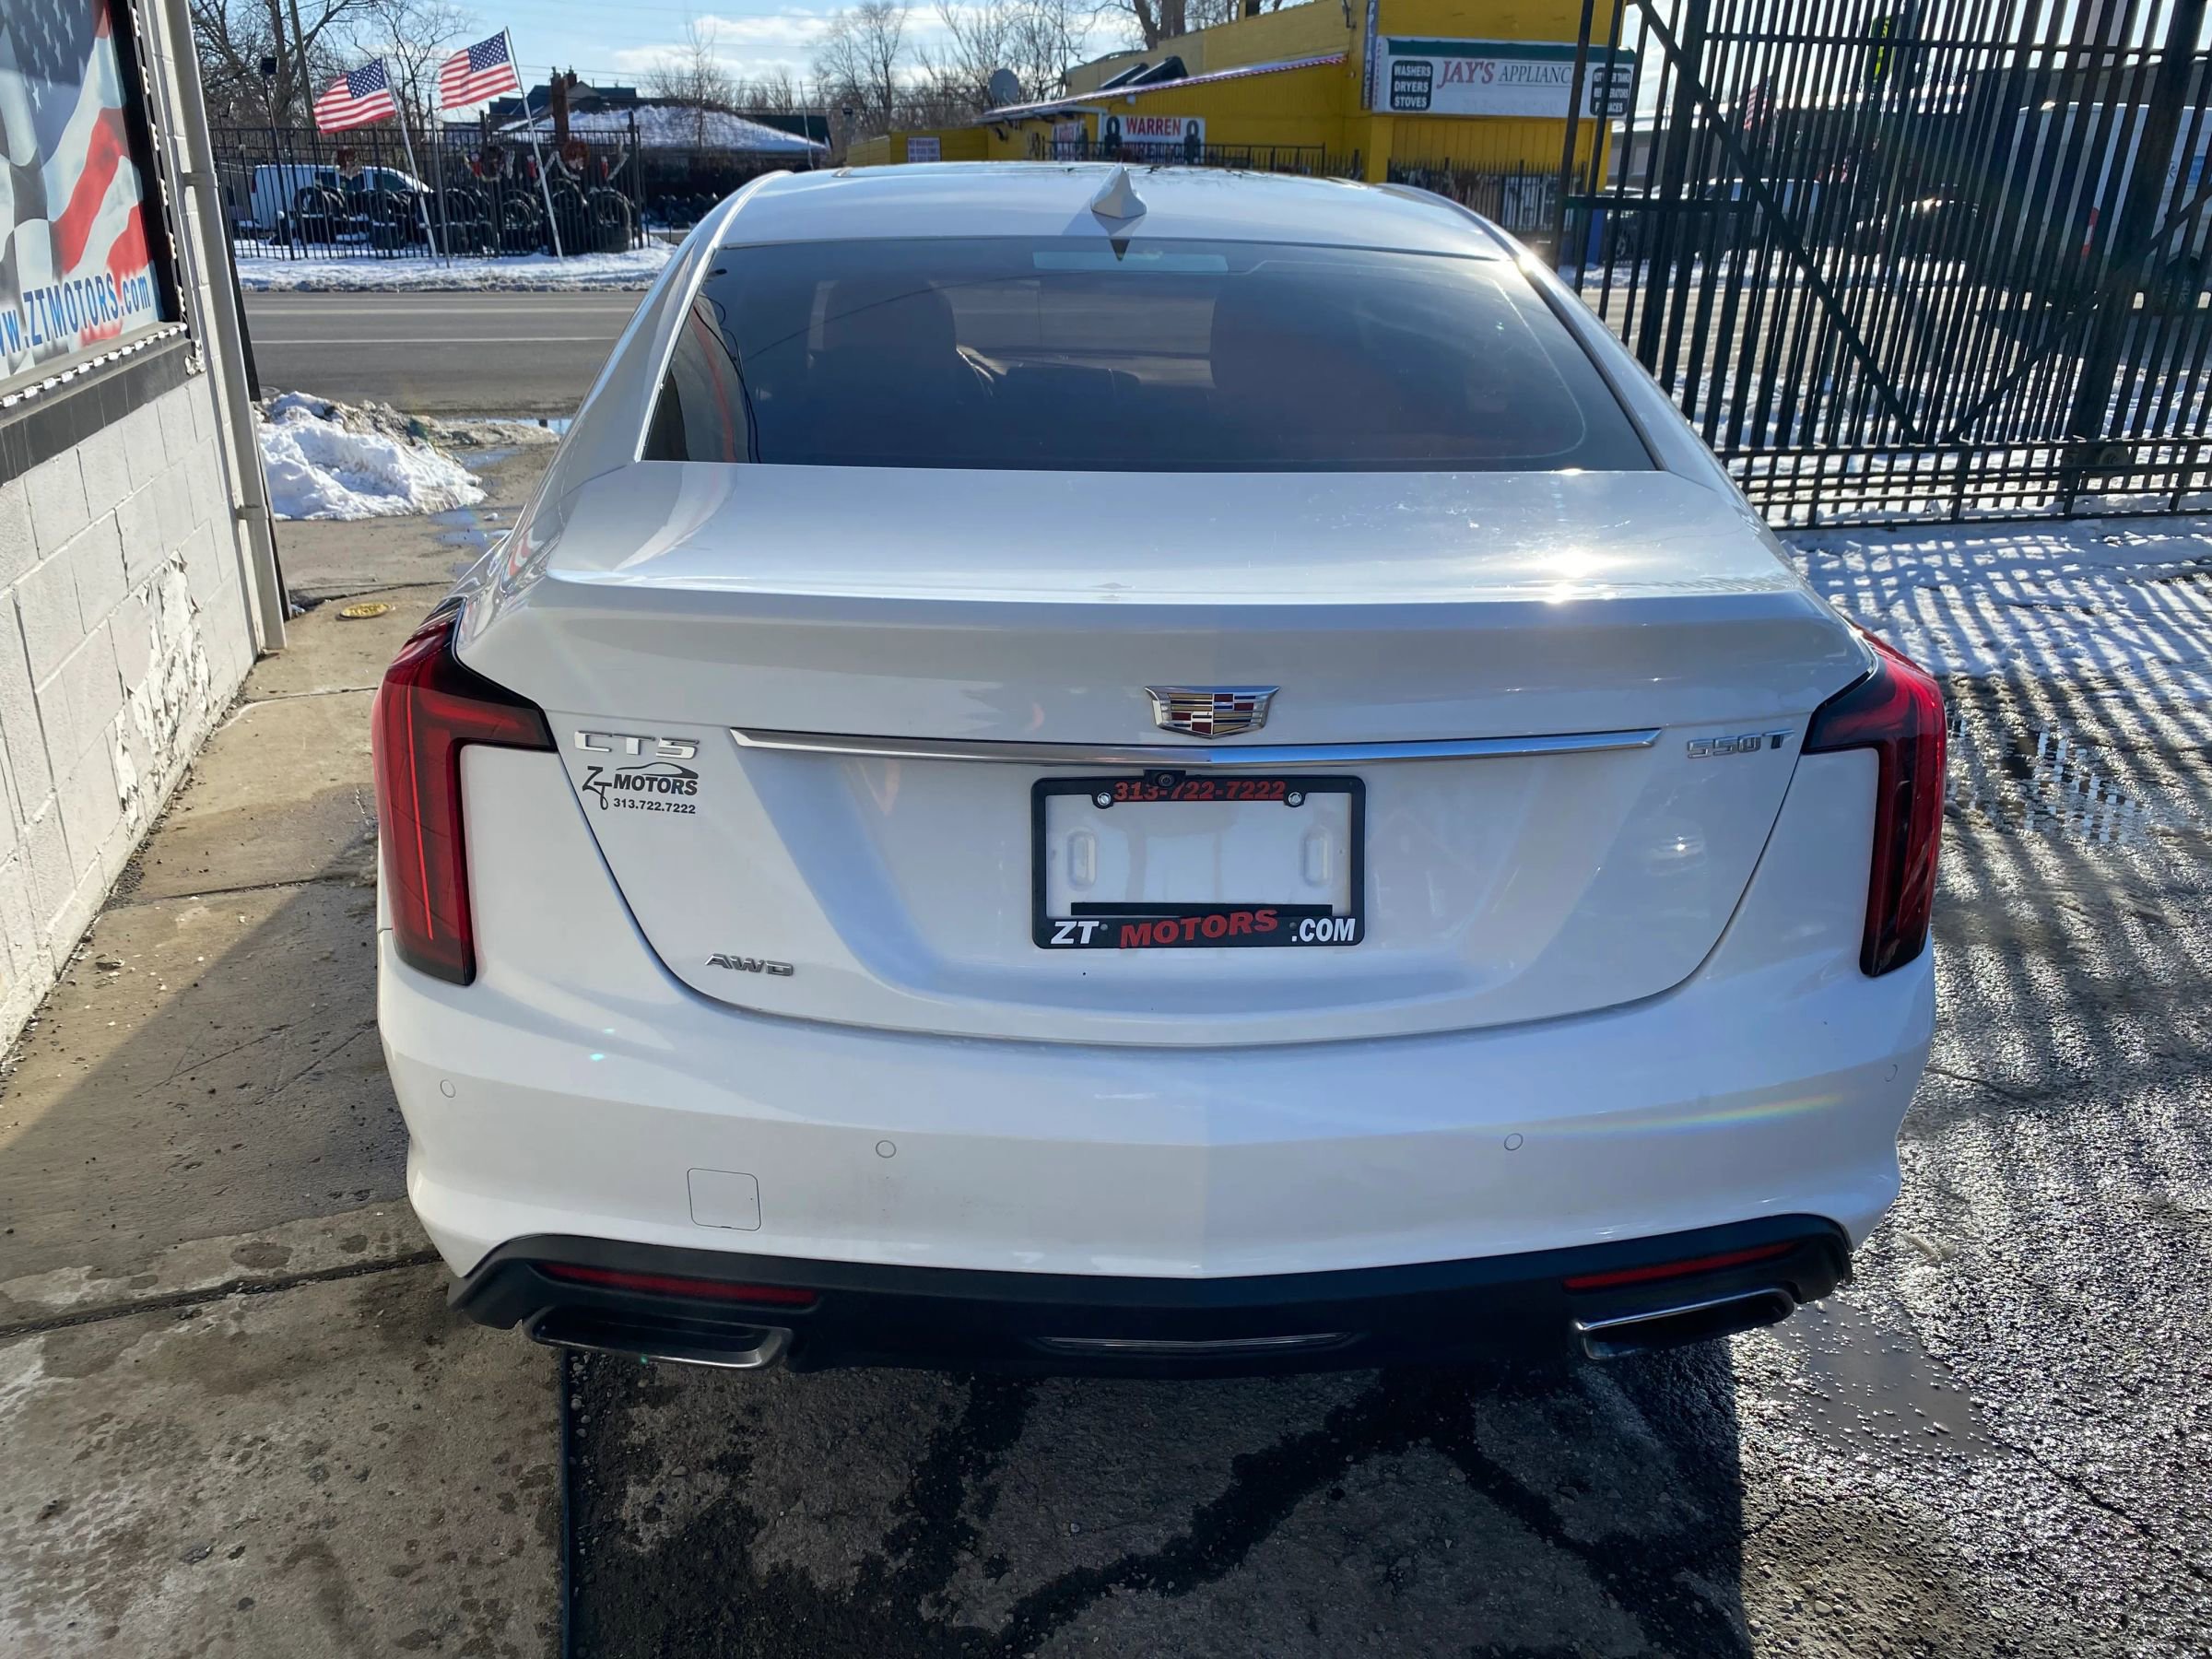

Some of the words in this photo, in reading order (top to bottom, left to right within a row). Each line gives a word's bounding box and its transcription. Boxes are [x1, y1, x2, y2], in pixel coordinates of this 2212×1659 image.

[1394, 65, 1431, 76] WASHERS
[1437, 60, 1495, 89] JAY'S
[1499, 65, 1587, 84] APPLIANC
[1394, 80, 1429, 93] DRYERS
[1394, 96, 1428, 108] STOVES
[1126, 116, 1182, 136] WARREN
[1688, 729, 1794, 759] 550T
[613, 773, 698, 796] MOTORS
[1113, 781, 1286, 801] 313-722-7222
[613, 797, 696, 815] 313.722.7222
[1051, 921, 1100, 945] ZT
[1120, 909, 1278, 948] MOTORS
[1291, 918, 1356, 943] .COM
[704, 953, 794, 977] AWD
